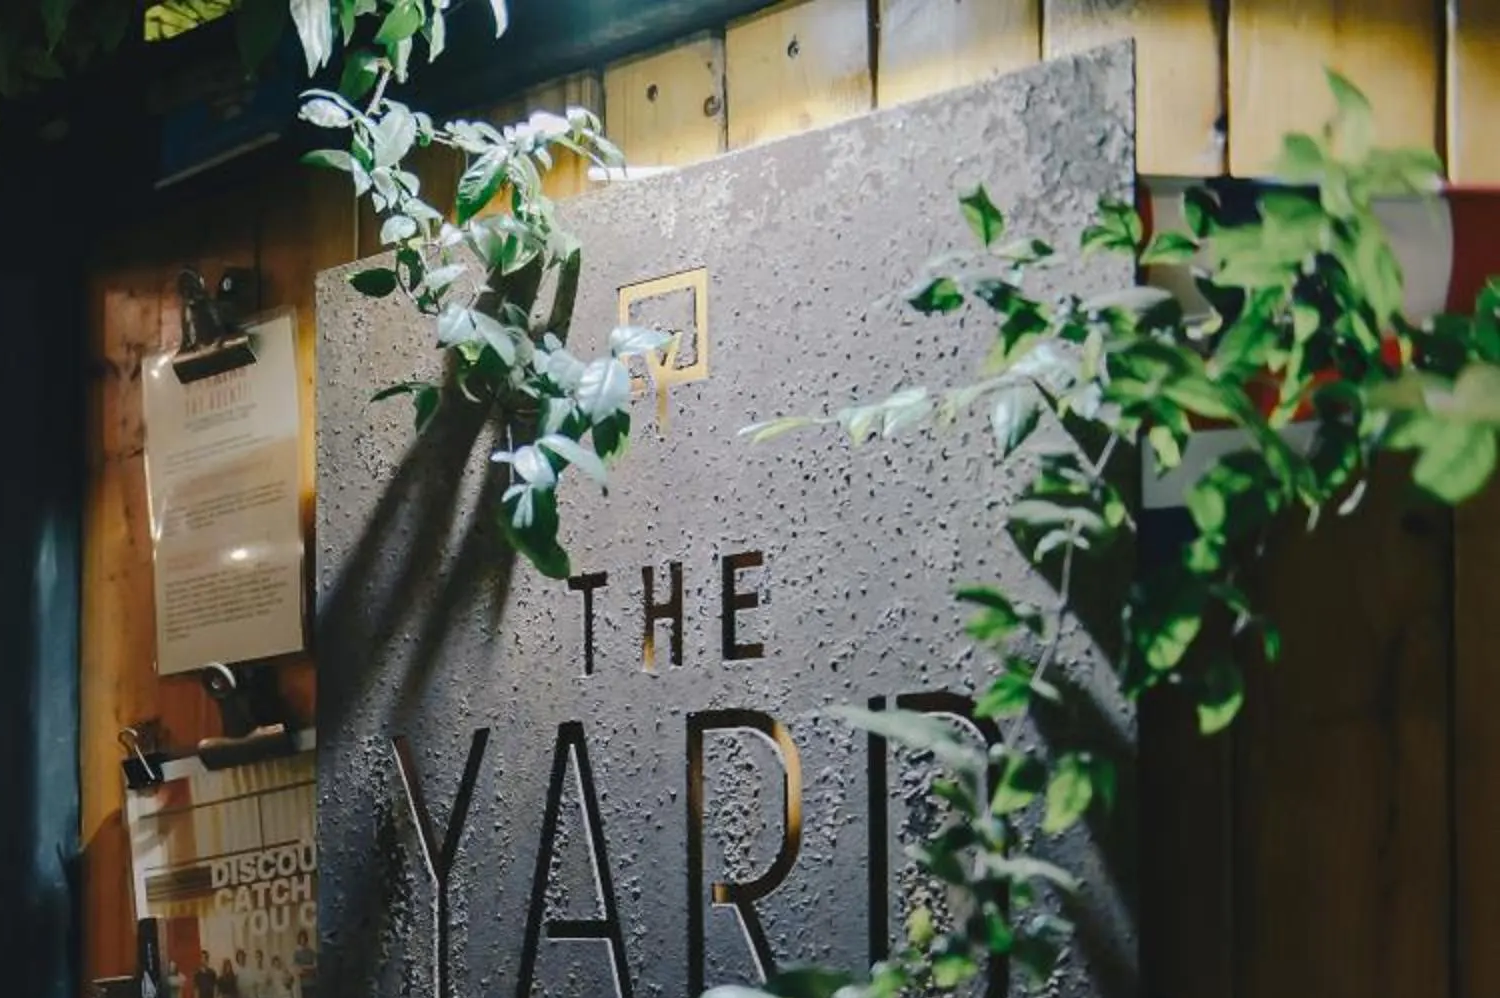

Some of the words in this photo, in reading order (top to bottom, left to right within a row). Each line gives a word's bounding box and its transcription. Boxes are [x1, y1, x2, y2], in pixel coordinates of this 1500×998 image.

[568, 550, 765, 677] THE
[211, 838, 317, 888] DISCOU
[215, 874, 311, 914] CATCH
[232, 905, 290, 940] YOU
[300, 900, 317, 928] C
